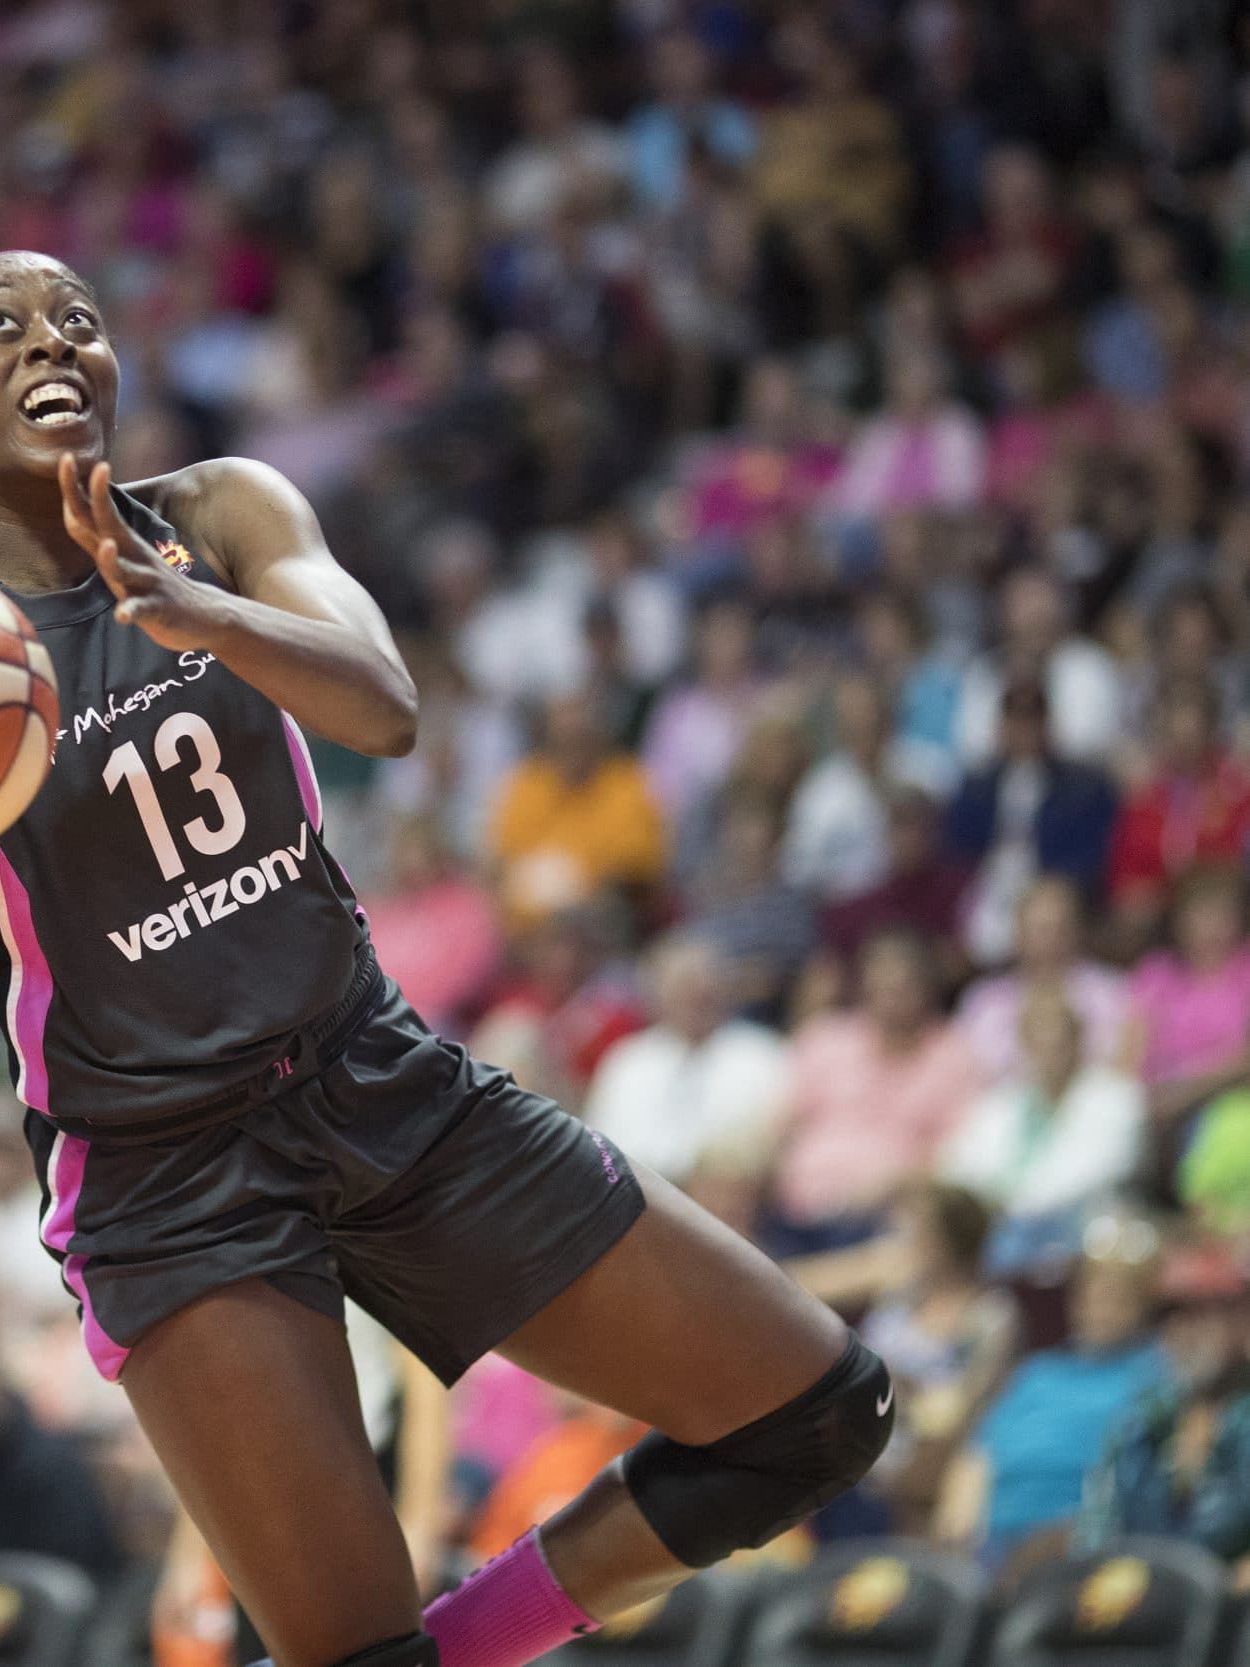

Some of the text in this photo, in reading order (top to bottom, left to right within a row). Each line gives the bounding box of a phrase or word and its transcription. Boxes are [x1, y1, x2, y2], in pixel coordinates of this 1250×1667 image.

[73, 650, 216, 745] Mohegan Su
[101, 711, 246, 882] 13
[106, 845, 302, 963] verizon
